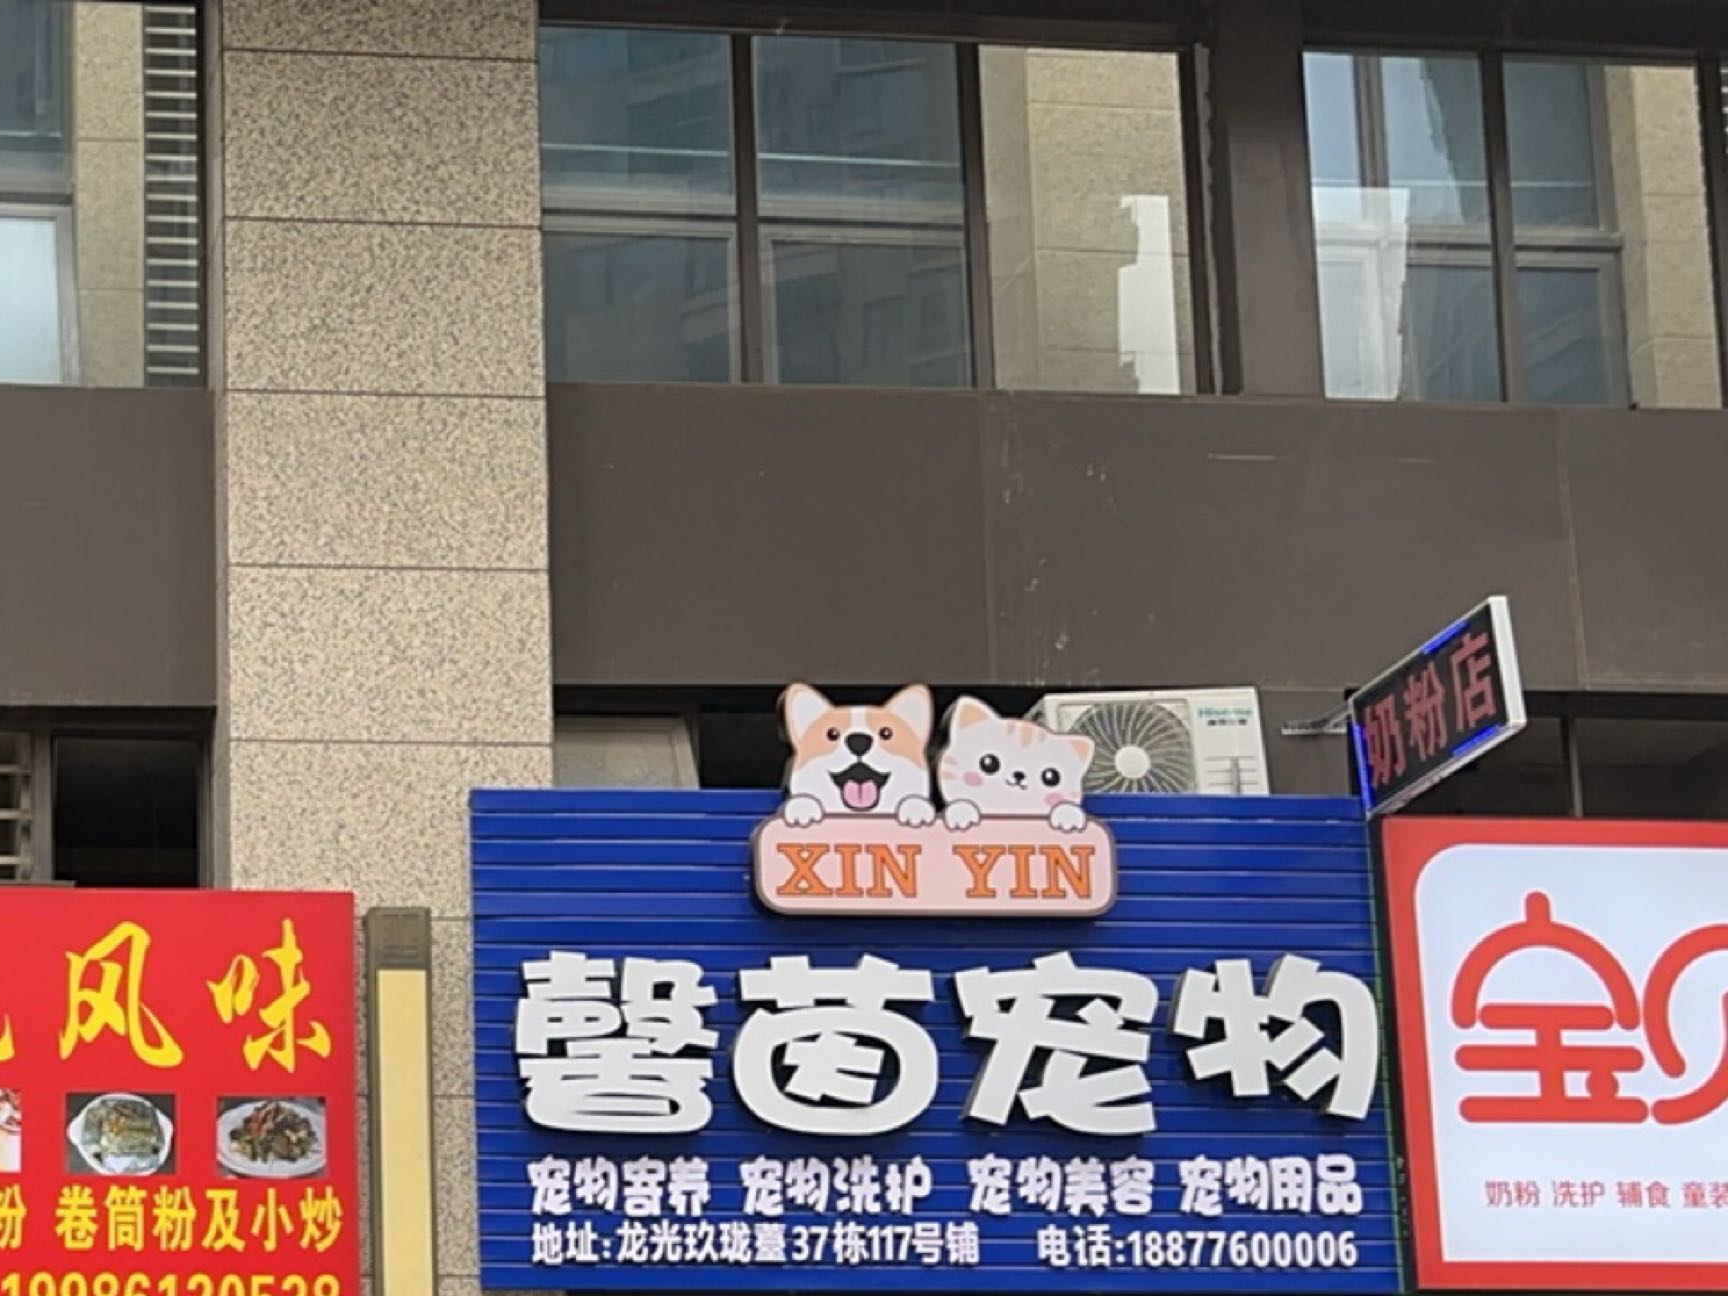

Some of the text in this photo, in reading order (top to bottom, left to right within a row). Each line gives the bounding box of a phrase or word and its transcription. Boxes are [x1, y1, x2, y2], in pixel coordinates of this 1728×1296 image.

[1364, 632, 1497, 788] 奶粉店
[776, 843, 1095, 899] XIN YIN
[516, 951, 1381, 1135] 馨茵宠物
[527, 1153, 1363, 1217] 宠物寄养 宠物洗护 宠物美容 宠物用品
[1485, 1180, 1541, 1209] 奶粉
[1551, 1180, 1607, 1209] 洗护
[1616, 1180, 1672, 1209] 辅食
[56, 1184, 344, 1253] 卷筒粉及小炒
